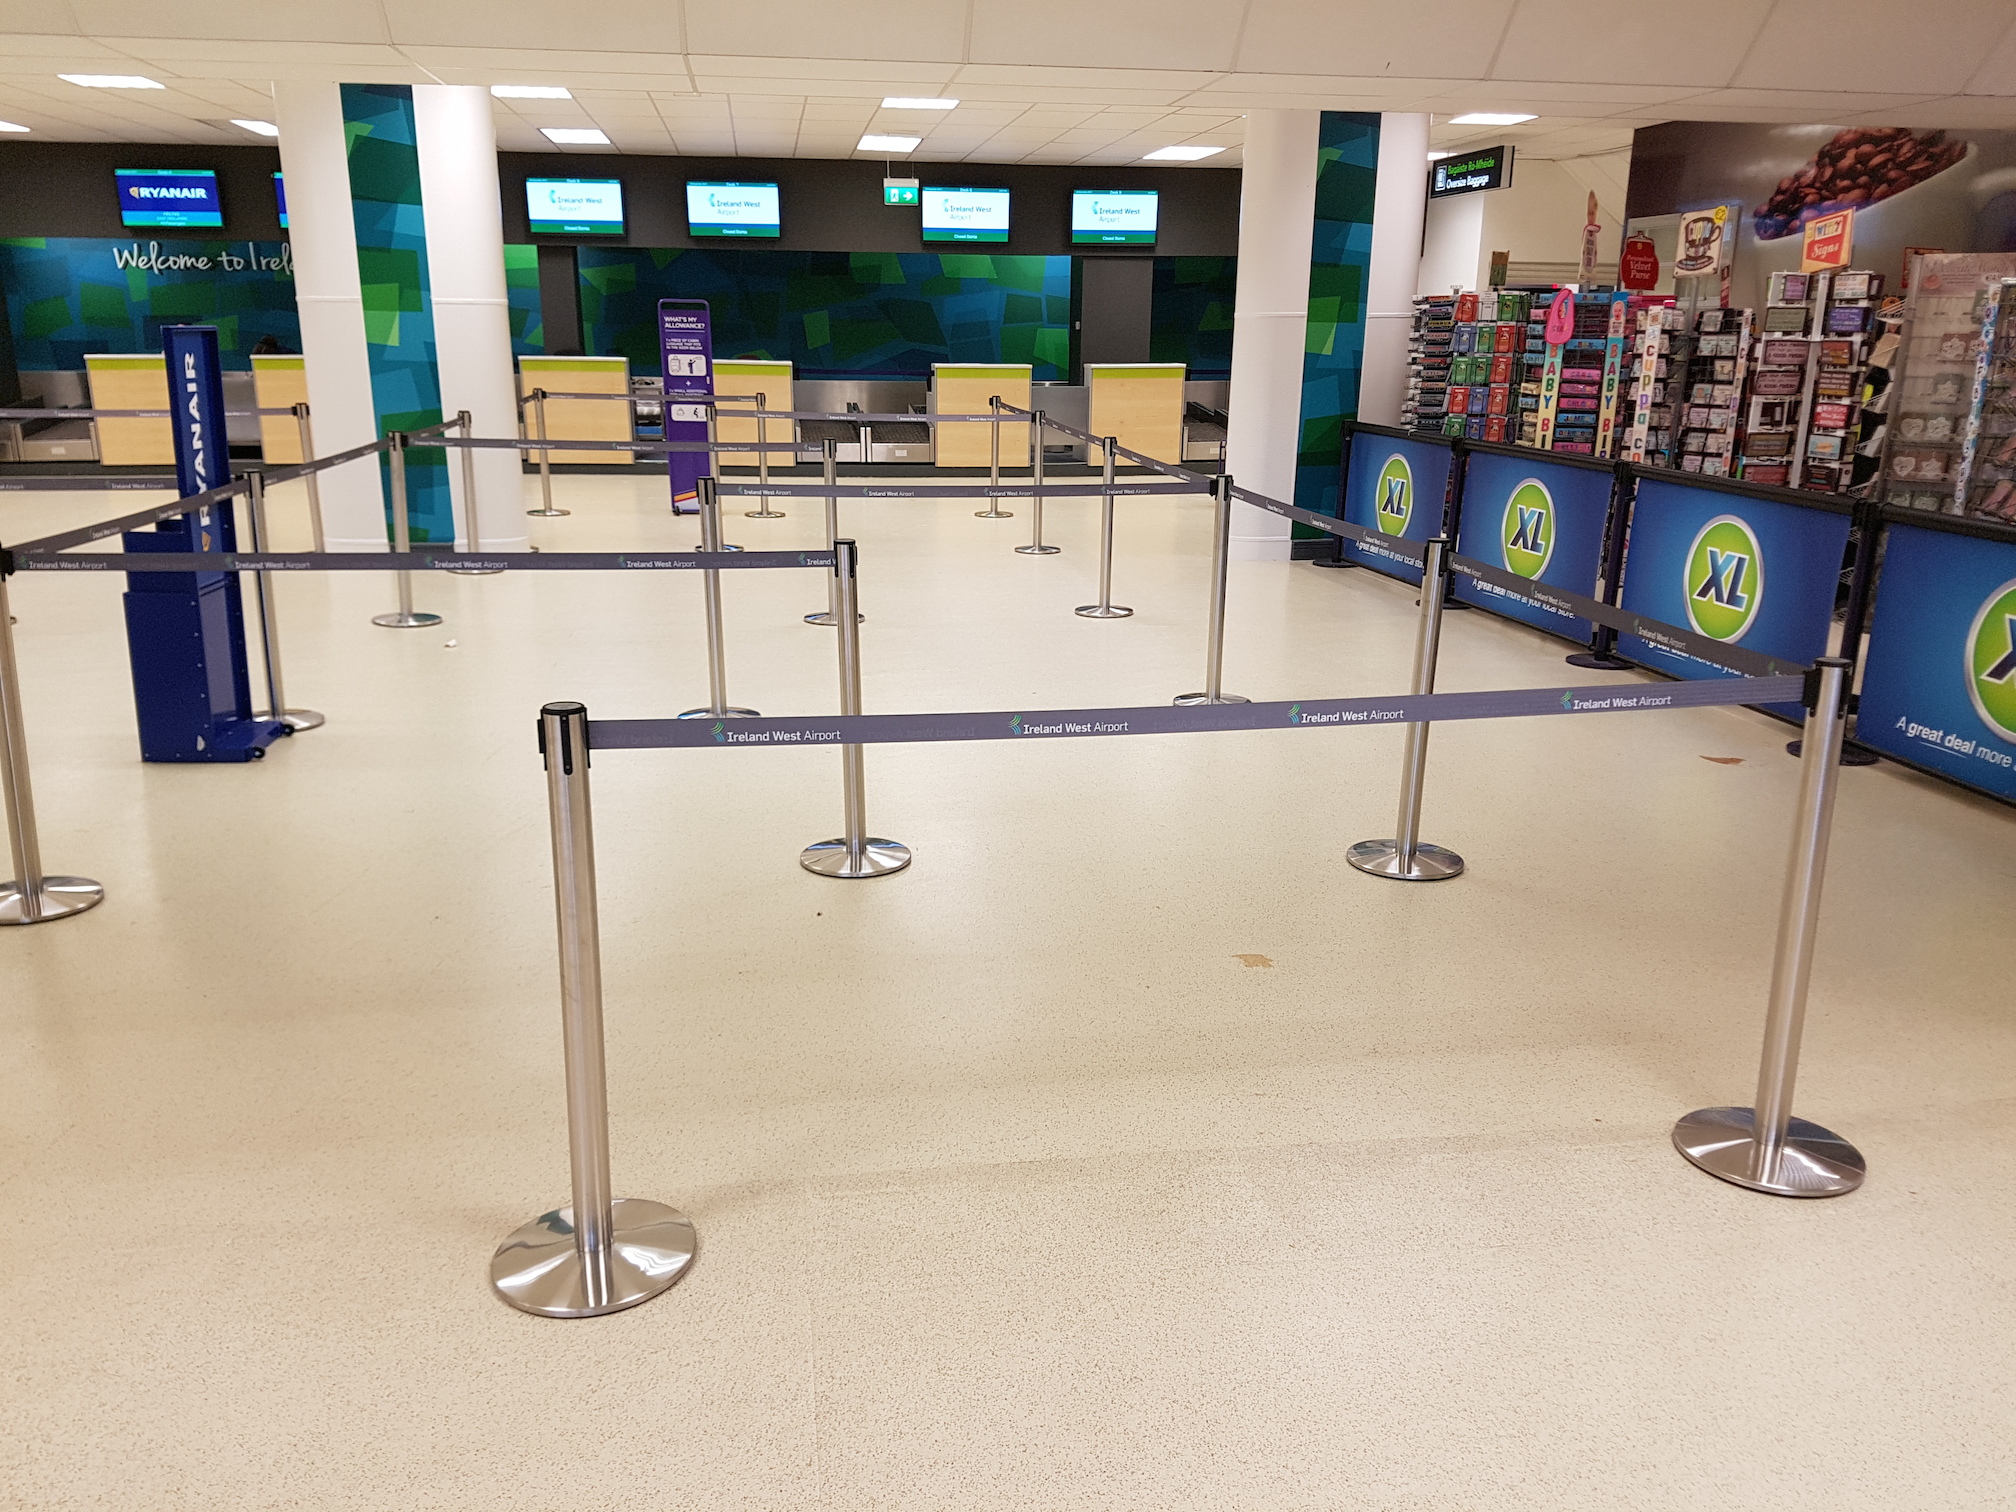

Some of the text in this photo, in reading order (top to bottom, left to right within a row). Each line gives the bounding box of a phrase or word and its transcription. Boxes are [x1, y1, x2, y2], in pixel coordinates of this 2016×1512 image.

[1446, 175, 1489, 189] Oversize Baggage
[140, 187, 208, 199] RYANAIR
[1811, 242, 1839, 259] Signs
[112, 241, 212, 275] Welcome
[217, 251, 244, 271] to
[1630, 271, 1650, 279] Purse
[1604, 343, 1619, 410] BABY
[1380, 476, 1407, 519] XL
[1507, 504, 1547, 556] XL
[806, 558, 831, 566] Ireland
[1379, 548, 1389, 558] more
[1394, 554, 1405, 562] your
[29, 560, 108, 570] Ireland West Airport
[235, 561, 311, 570] Ireland West Airport
[434, 561, 509, 570] Ireland West Airport
[626, 560, 696, 569] Ireland West Airport
[1692, 546, 1750, 612] XL
[1477, 580, 1492, 591] great
[1506, 590, 1522, 601] more
[1638, 626, 1686, 650] Ireland West Airport
[1573, 696, 1672, 710] Ireland West Airport
[1301, 709, 1405, 724] Ireland West Airport
[1023, 721, 1129, 735] Ireland West Airport
[727, 730, 842, 743] Ireland West Airport
[1895, 716, 2013, 768] A great deal more
